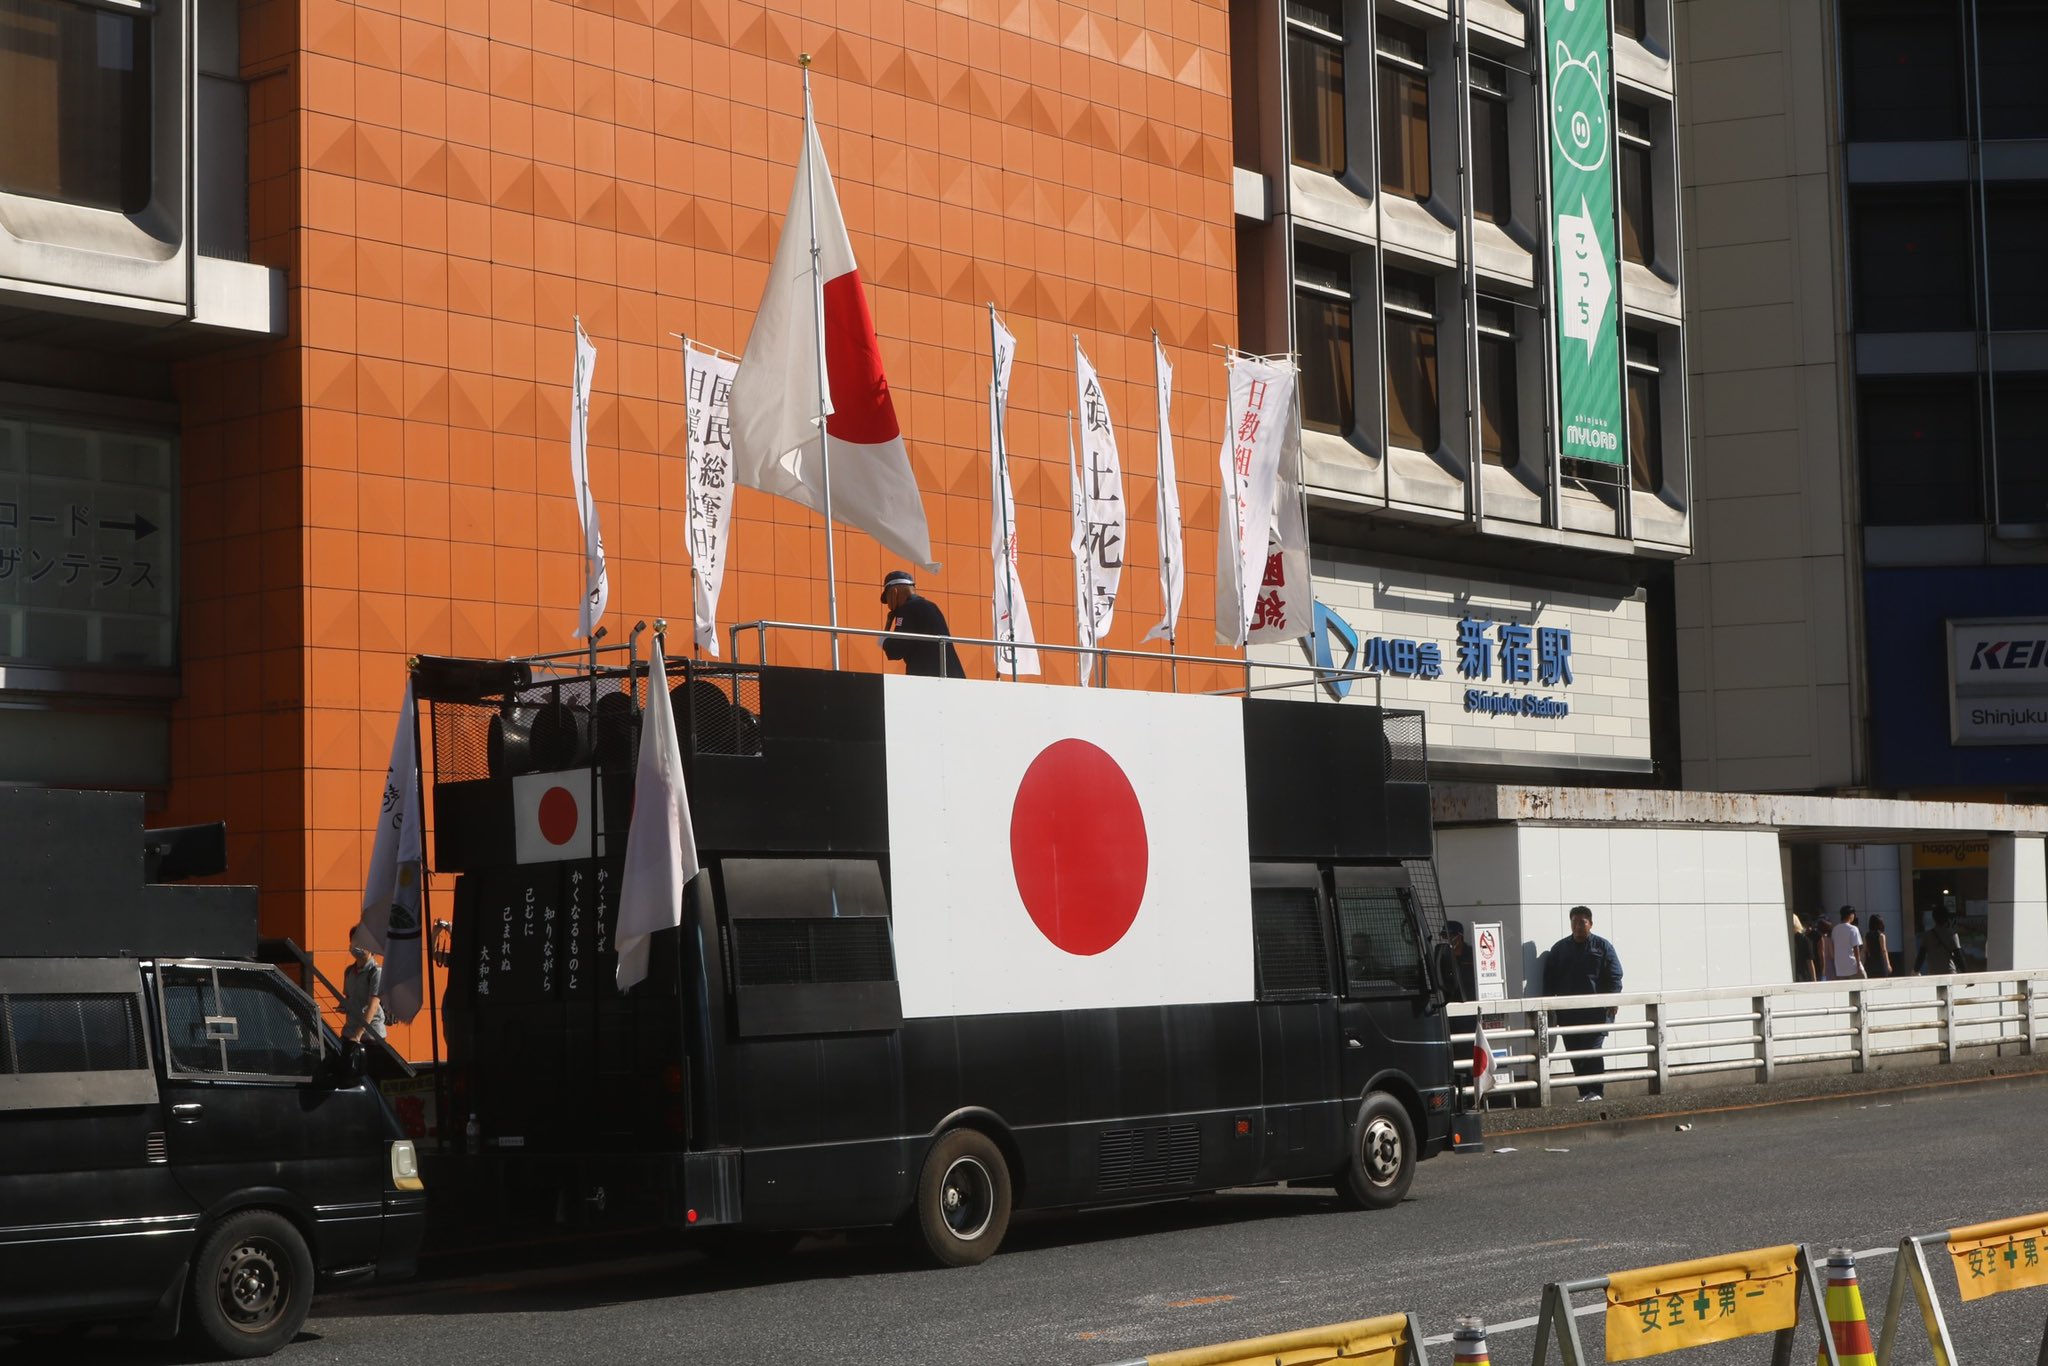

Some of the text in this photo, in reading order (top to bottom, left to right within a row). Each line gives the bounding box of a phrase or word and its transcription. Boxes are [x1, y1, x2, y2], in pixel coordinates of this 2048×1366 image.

[1575, 232, 1590, 325] こっち
[1566, 425, 1618, 451] MYLORD
[1575, 414, 1608, 427] shinjuku
[1364, 614, 1574, 687] 小田急 新宿駅
[1969, 640, 2048, 671] KEI
[1466, 689, 1569, 718] Shinjuku Station
[1971, 708, 2048, 726] Shinjuku
[542, 906, 555, 992] 知りながら
[568, 869, 583, 990] かくなるものと
[477, 945, 491, 996] 大和魂
